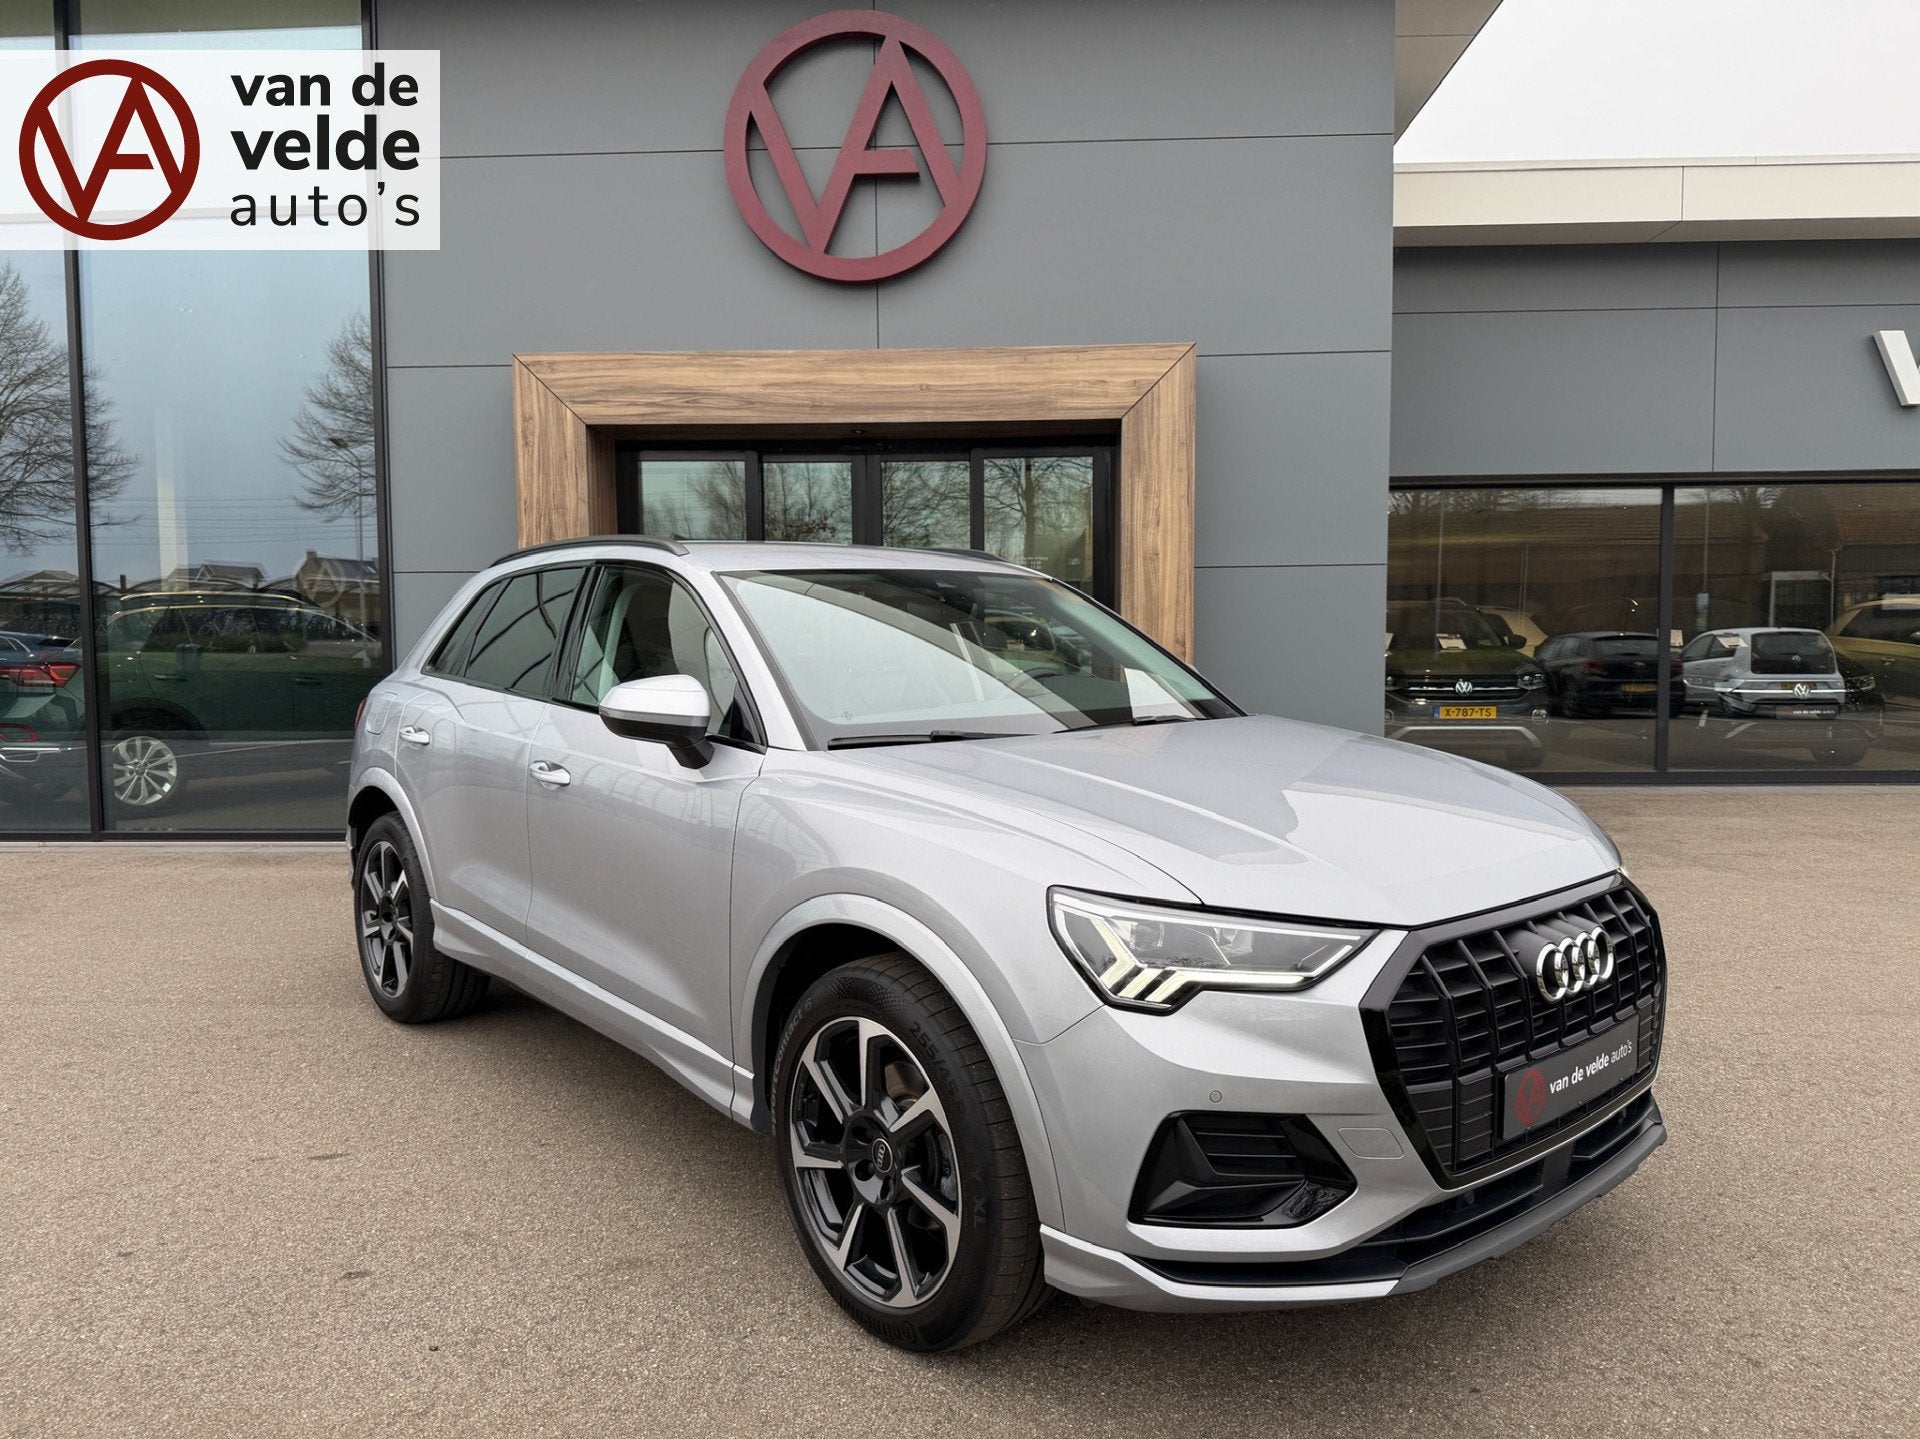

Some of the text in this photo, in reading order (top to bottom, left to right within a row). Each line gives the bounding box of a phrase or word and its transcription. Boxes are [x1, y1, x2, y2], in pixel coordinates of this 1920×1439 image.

[1444, 707, 1492, 717] X-787-TS
[1549, 1039, 1633, 1094] van de velde auto's
